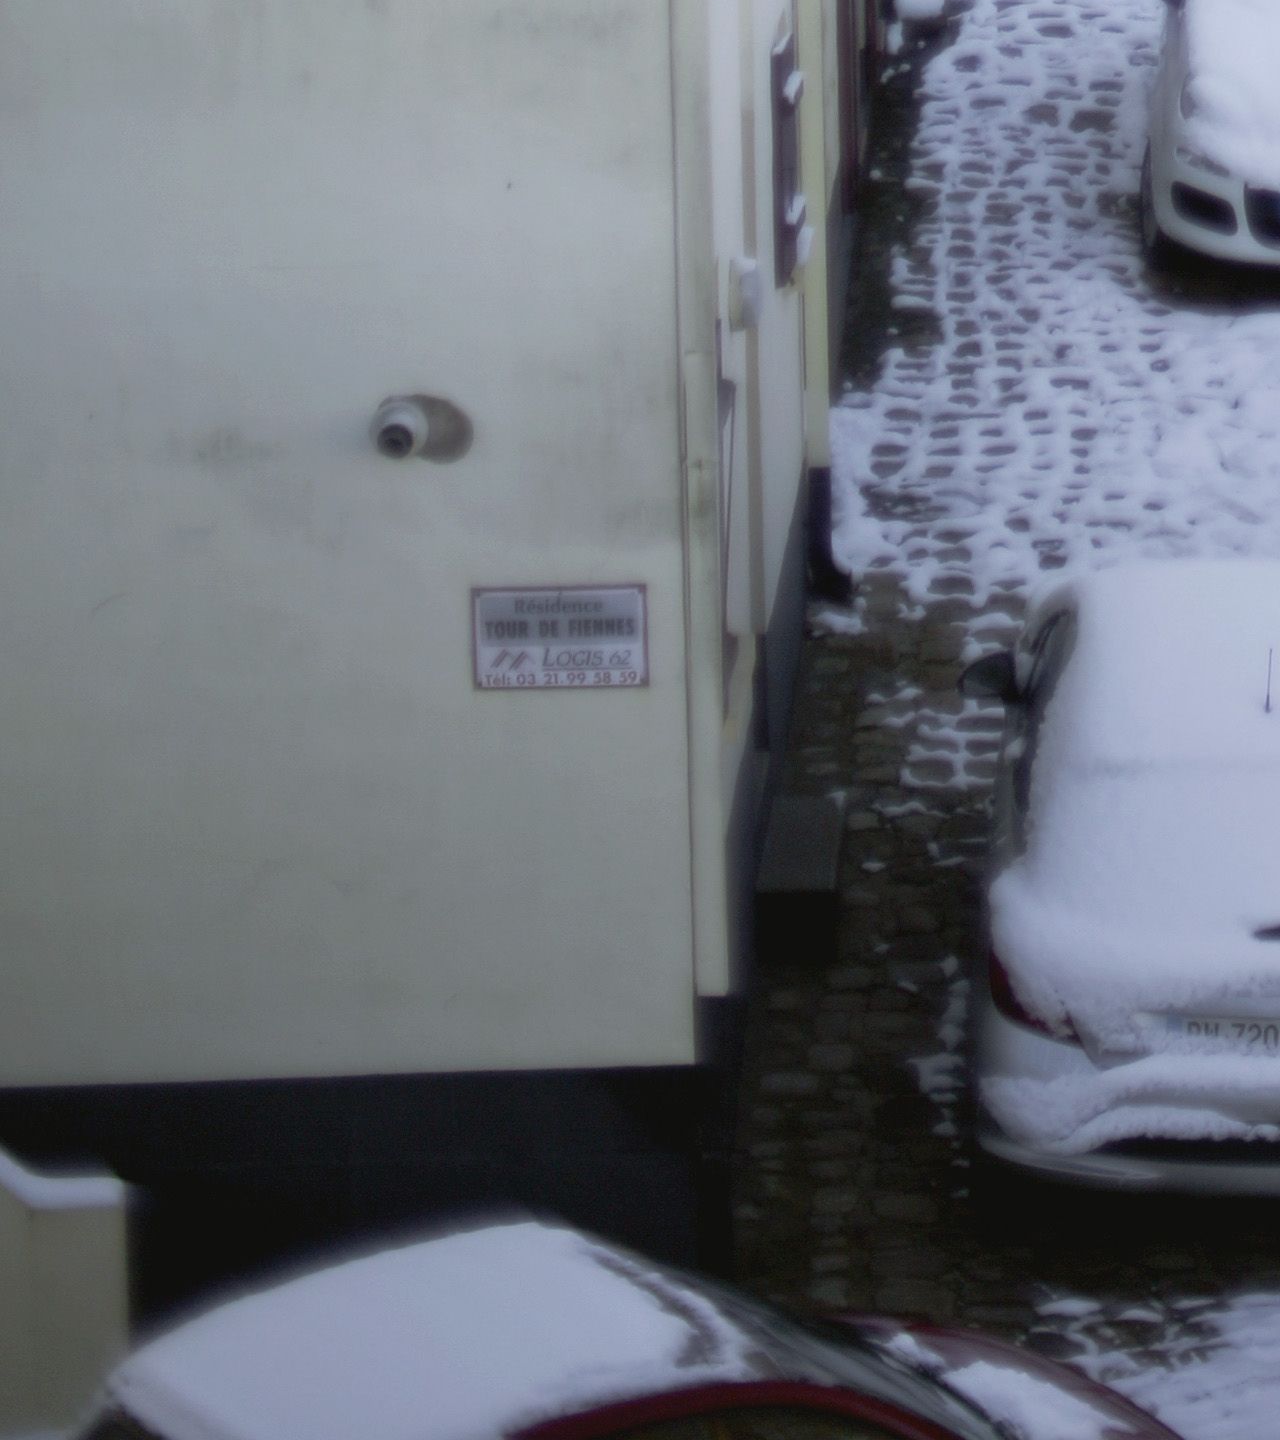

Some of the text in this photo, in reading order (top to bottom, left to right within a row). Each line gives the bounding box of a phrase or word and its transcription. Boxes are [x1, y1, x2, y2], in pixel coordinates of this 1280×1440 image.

[513, 595, 604, 615] Résidence
[484, 617, 635, 639] TOUR DE FIENNES
[609, 649, 632, 666] 62
[516, 673, 537, 686] 03
[593, 671, 612, 685] 58
[618, 670, 638, 684] 59
